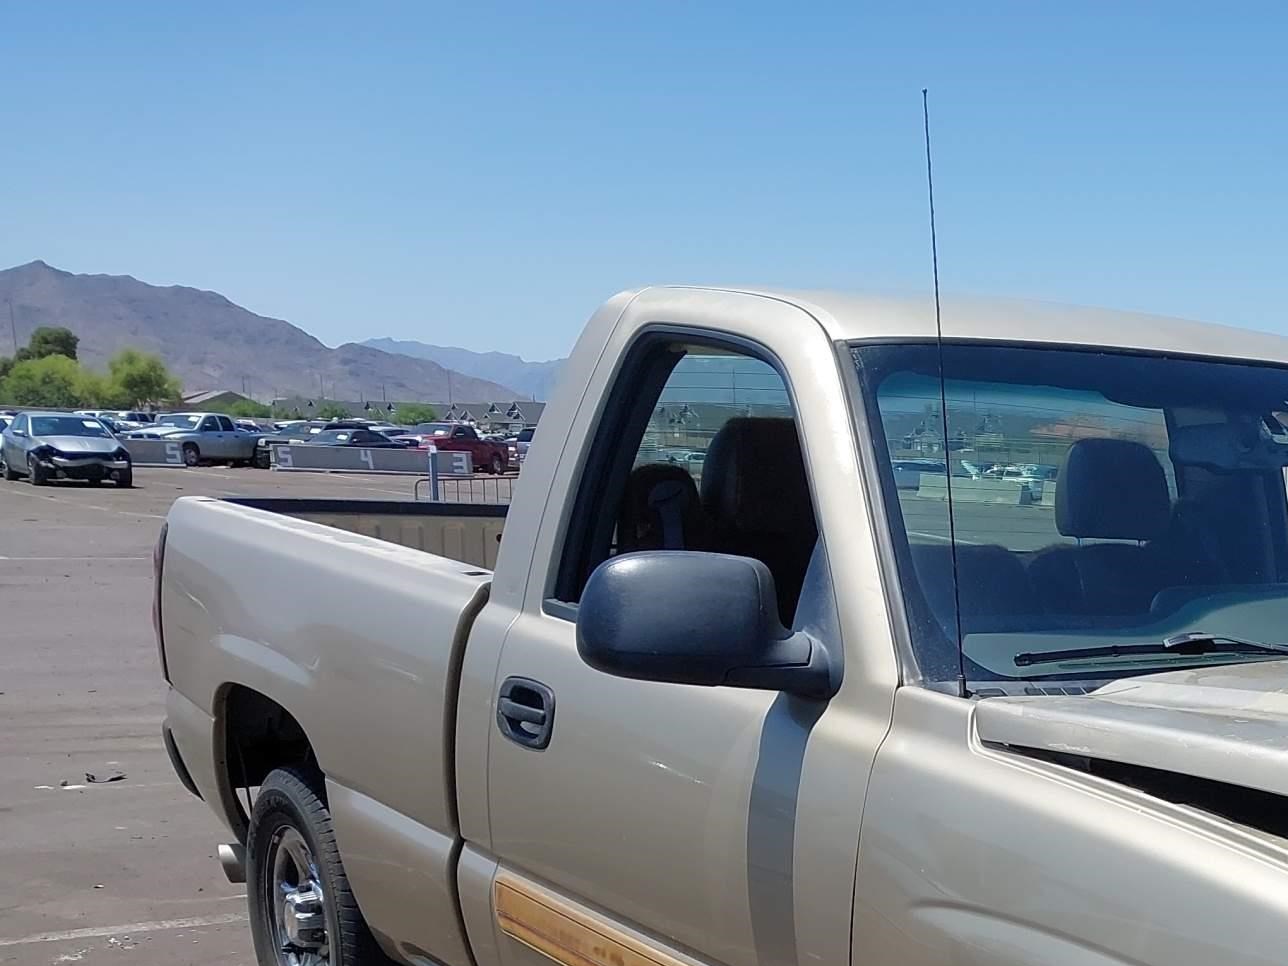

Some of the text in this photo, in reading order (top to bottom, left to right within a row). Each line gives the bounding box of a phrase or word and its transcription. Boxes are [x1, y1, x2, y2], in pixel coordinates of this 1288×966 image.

[165, 442, 182, 463] 5
[359, 449, 375, 470] 4
[452, 453, 468, 474] 3
